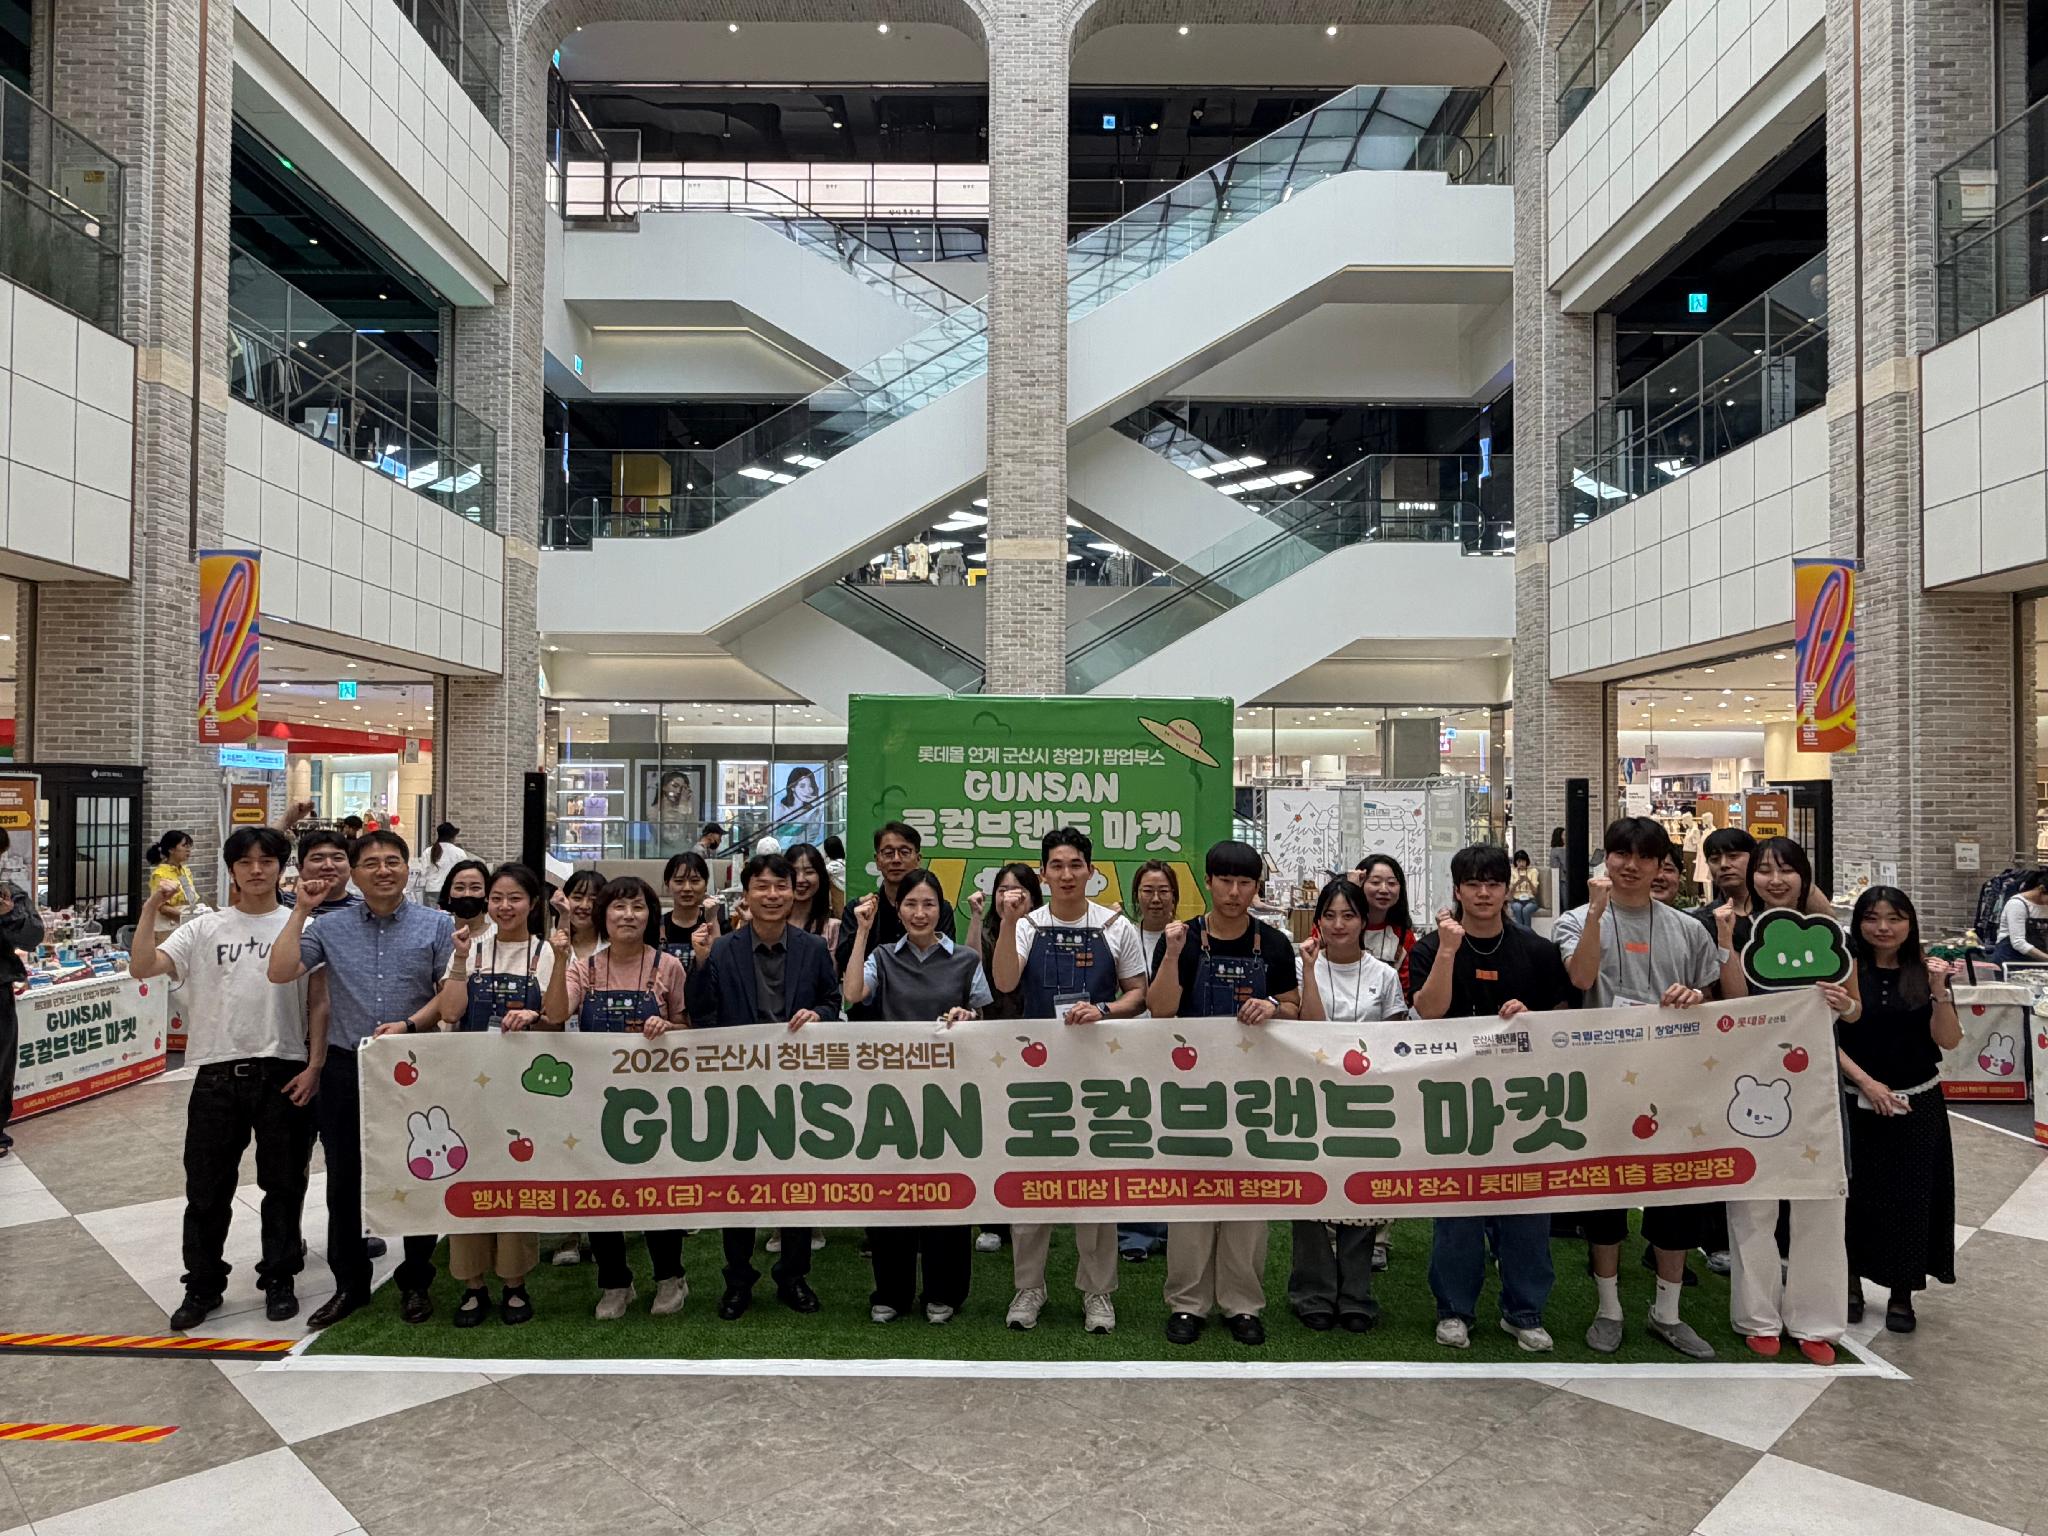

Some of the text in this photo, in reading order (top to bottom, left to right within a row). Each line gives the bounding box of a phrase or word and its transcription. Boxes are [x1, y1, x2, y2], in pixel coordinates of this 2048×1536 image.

[917, 745, 1166, 767] 롯데몰 연계 군산시 창업가 팝업부스
[963, 769, 1120, 803] GUNSAN
[1101, 809, 1182, 852] 마켓
[47, 1001, 112, 1032] GUNSAN
[1571, 1027, 1644, 1042] 국립군산대학교
[1655, 1021, 1700, 1036] 창업지원단
[1737, 1014, 1767, 1028] 롯데몰
[19, 1027, 103, 1069] 로컬브랜드
[105, 1016, 137, 1045] 마켓
[612, 1042, 955, 1074] 2026 군산시 청년뜰 창업센터
[1414, 1042, 1457, 1055] 군산시
[601, 1071, 1588, 1165] GUNSAN 로컬브랜드 마켓
[1022, 1180, 1062, 1200] 참여
[1067, 1179, 1109, 1200] 대상
[1127, 1177, 1188, 1199] 군산시
[1193, 1177, 1234, 1199] 소재
[1240, 1178, 1302, 1199] 창업가
[1370, 1177, 1413, 1199] 행사
[1419, 1176, 1460, 1197] 장소
[1480, 1170, 1543, 1195] 롯데몰
[1548, 1166, 1611, 1190] 군산점
[1615, 1165, 1646, 1187] 1층
[1652, 1157, 1736, 1184] 중앙광장
[472, 1189, 513, 1210] 행사
[518, 1188, 556, 1210] 일정
[574, 1188, 606, 1210] 26.
[611, 1188, 630, 1209] 6.
[635, 1187, 662, 1208] 19.
[667, 1184, 703, 1207] (금)
[726, 1184, 746, 1205] 6.
[750, 1183, 777, 1205] 21.
[782, 1182, 817, 1205] (일)
[822, 1182, 874, 1204] 10:30
[897, 1182, 951, 1203] 21:00
